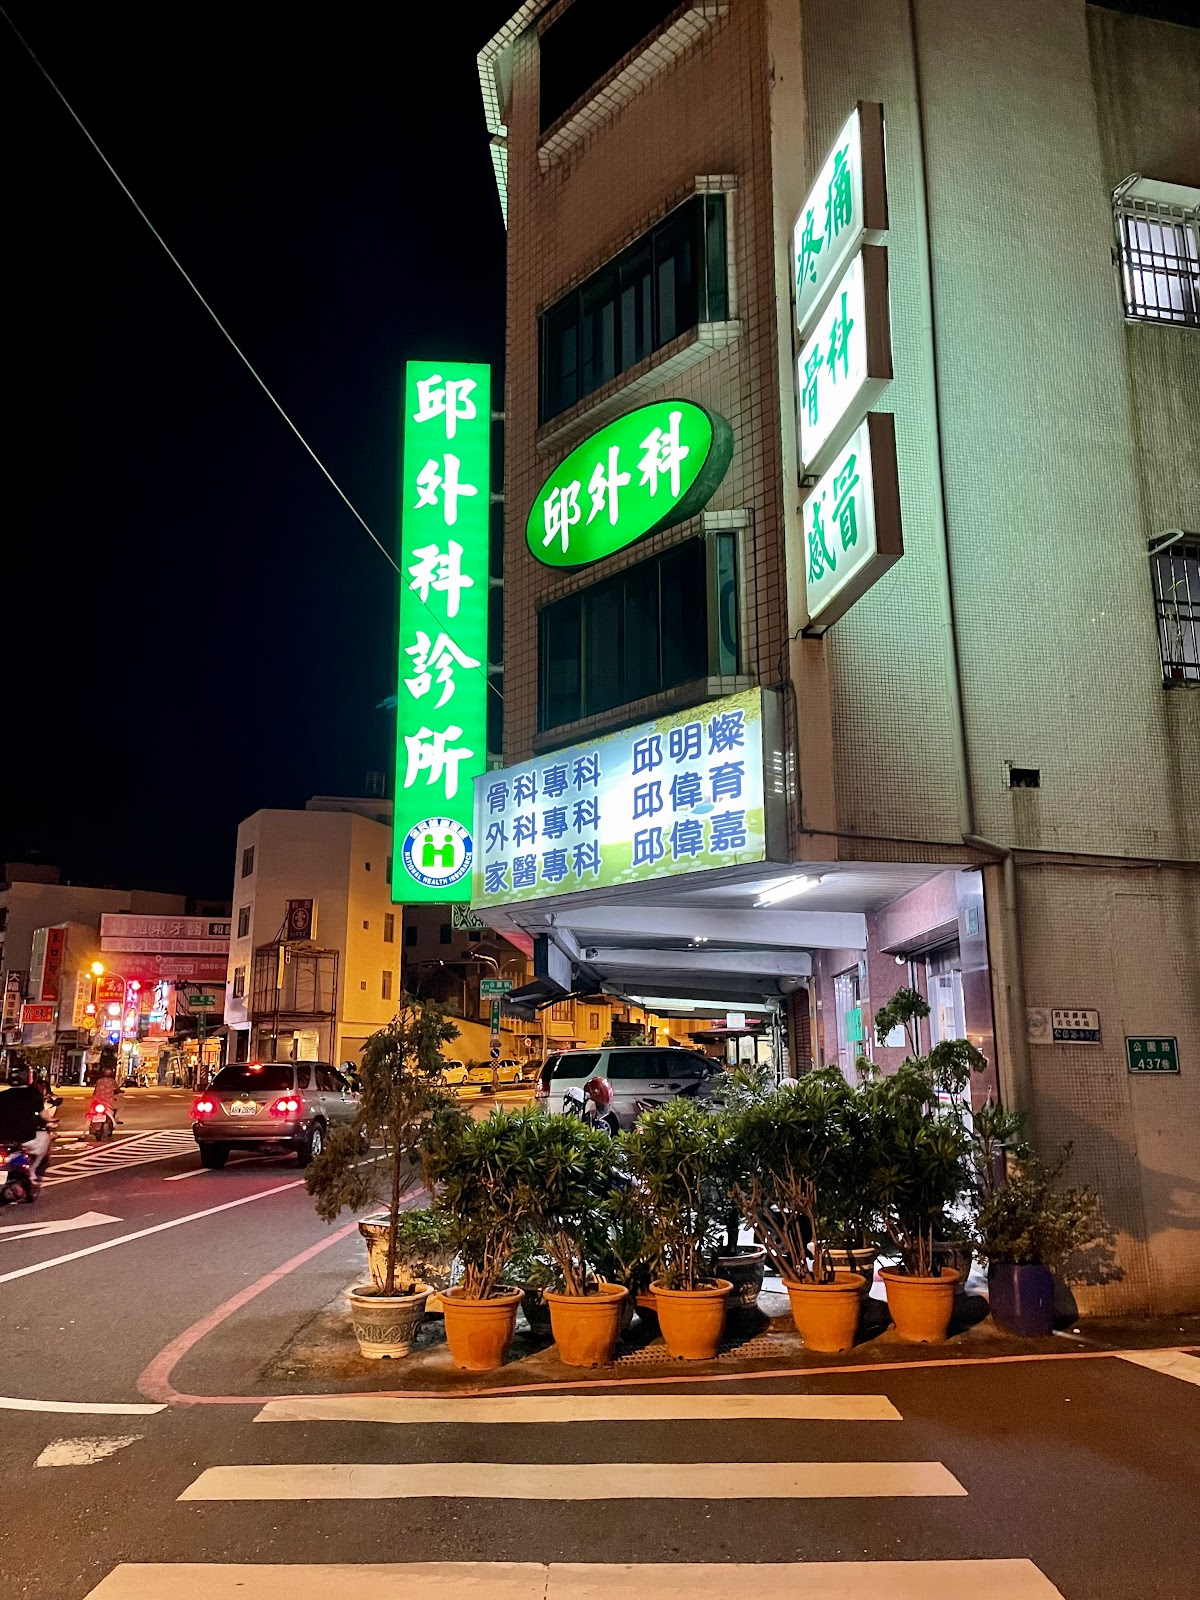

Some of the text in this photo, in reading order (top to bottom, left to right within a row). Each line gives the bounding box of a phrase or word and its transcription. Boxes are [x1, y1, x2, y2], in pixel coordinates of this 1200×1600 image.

[797, 142, 853, 296] 疼痛
[801, 291, 855, 427] 骨科
[542, 410, 690, 554] 邱外科
[404, 373, 481, 801] 邱外科診所
[486, 710, 745, 814] 骨科專科 邱明燦
[486, 760, 745, 853] 外科專科 邱偉育
[404, 851, 473, 886] NATIONAL HEALTH INSURANCE
[485, 810, 747, 893] 家醫專科 邱偉嘉
